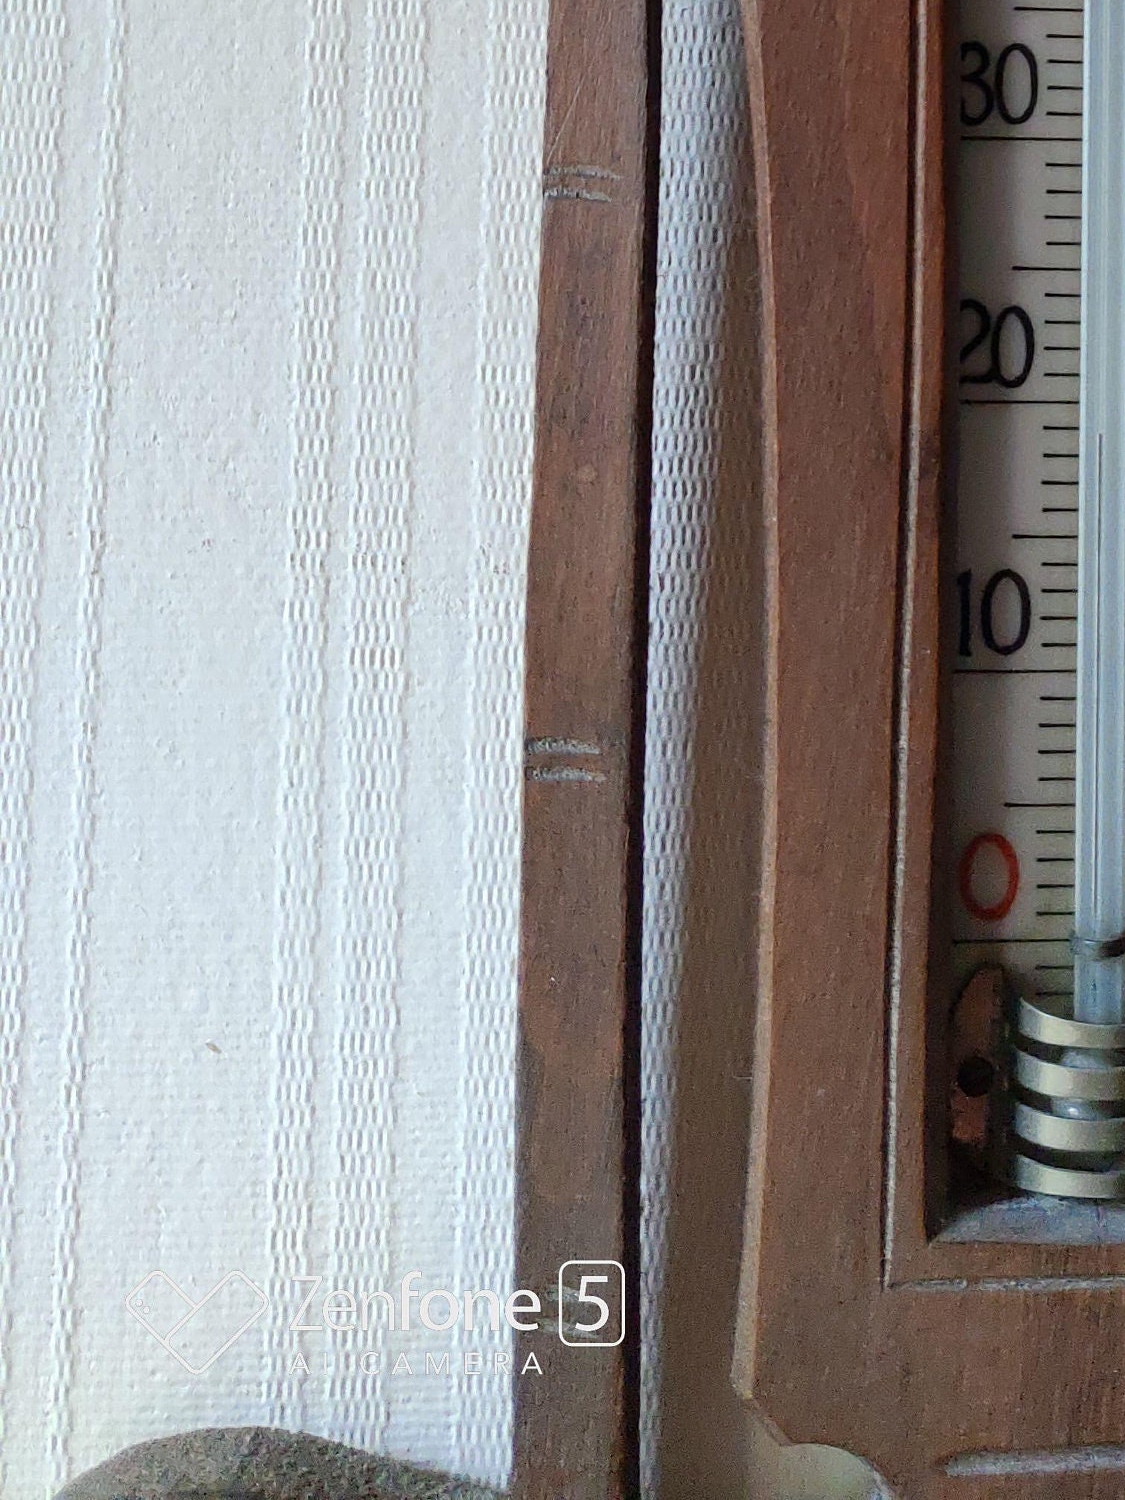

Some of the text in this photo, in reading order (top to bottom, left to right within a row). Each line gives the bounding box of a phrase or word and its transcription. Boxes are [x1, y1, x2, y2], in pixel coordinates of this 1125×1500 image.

[960, 41, 1039, 126] 30
[959, 298, 1035, 389] 20
[957, 568, 1032, 657] 10
[960, 833, 1019, 922] 0
